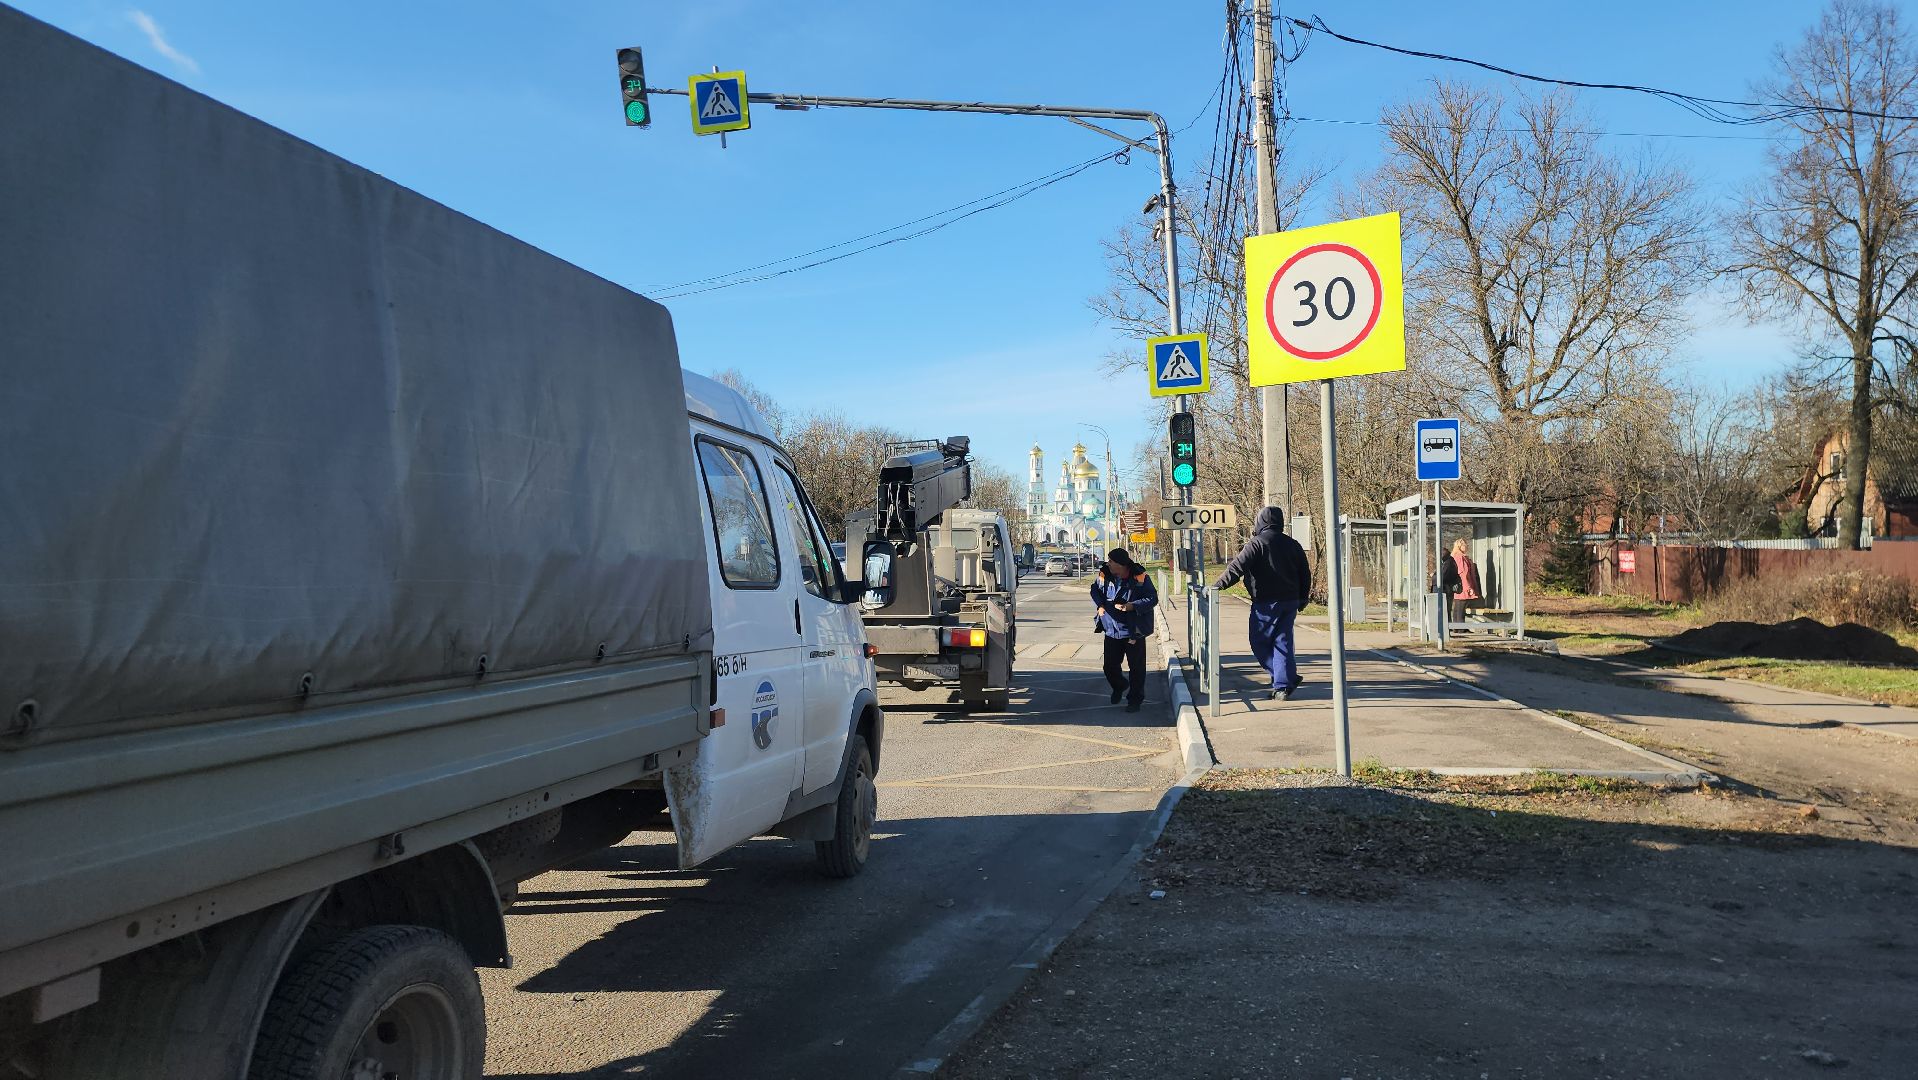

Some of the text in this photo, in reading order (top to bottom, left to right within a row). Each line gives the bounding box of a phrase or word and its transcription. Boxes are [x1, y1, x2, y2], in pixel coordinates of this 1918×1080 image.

[626, 79, 642, 93] 34
[1292, 276, 1356, 327] 30
[1177, 443, 1193, 457] 34
[1172, 509, 1226, 525] СТОП
